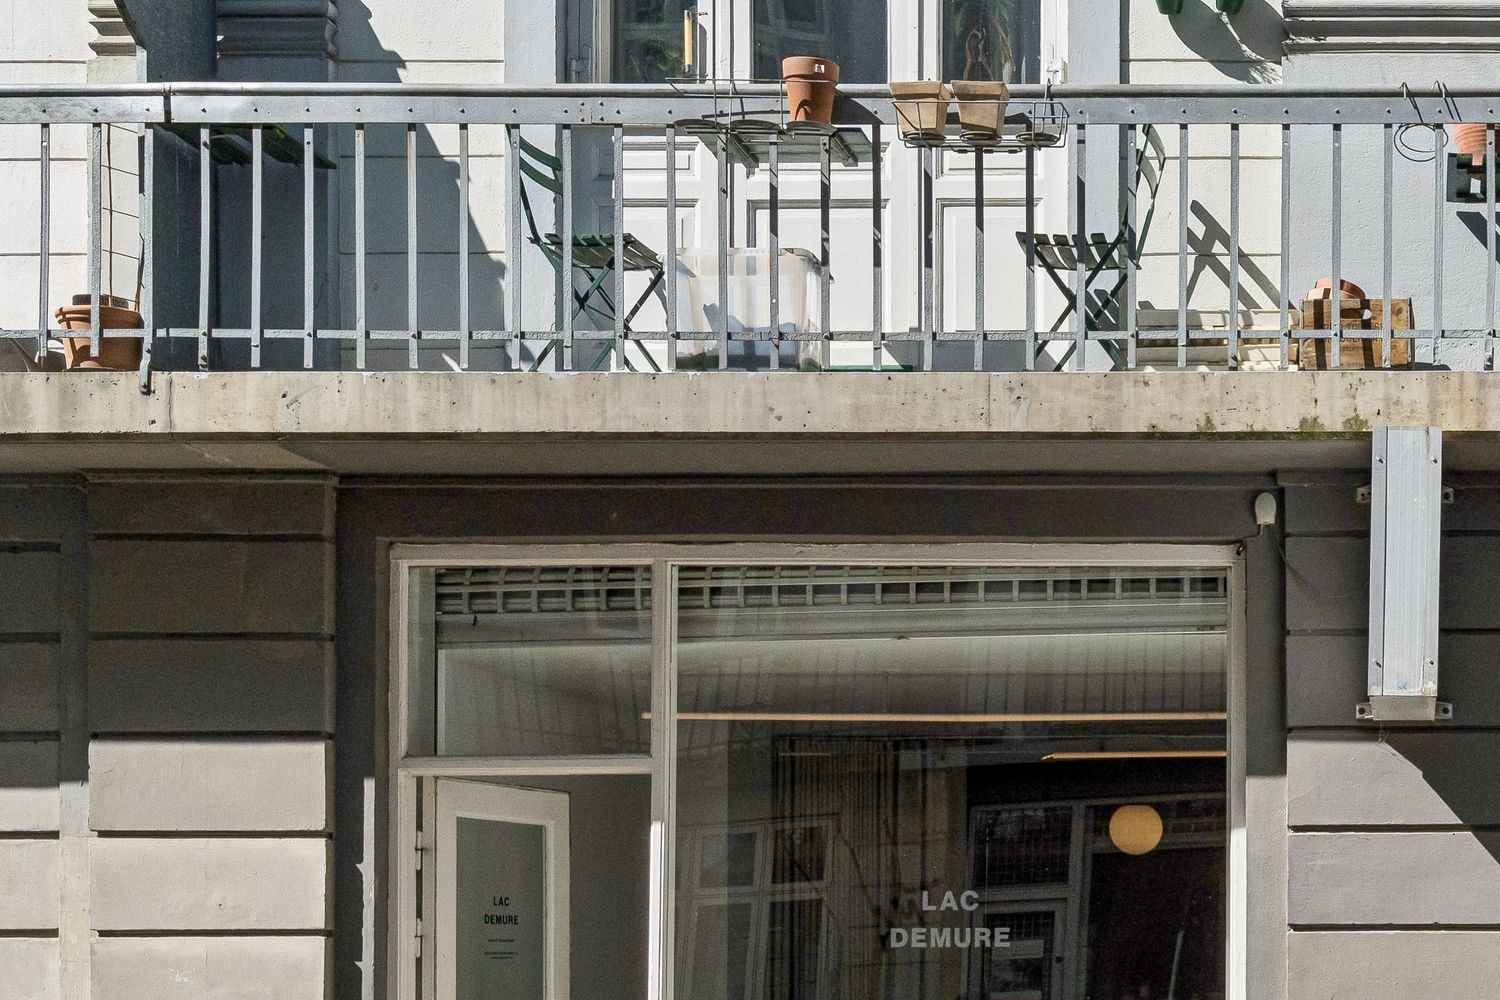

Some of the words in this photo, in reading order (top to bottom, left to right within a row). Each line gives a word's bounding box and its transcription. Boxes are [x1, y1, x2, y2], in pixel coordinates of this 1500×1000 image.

[492, 896, 510, 907] LAC
[922, 890, 979, 911] LAC
[484, 914, 519, 925] DEMURE
[890, 927, 1011, 948] DEMURE
